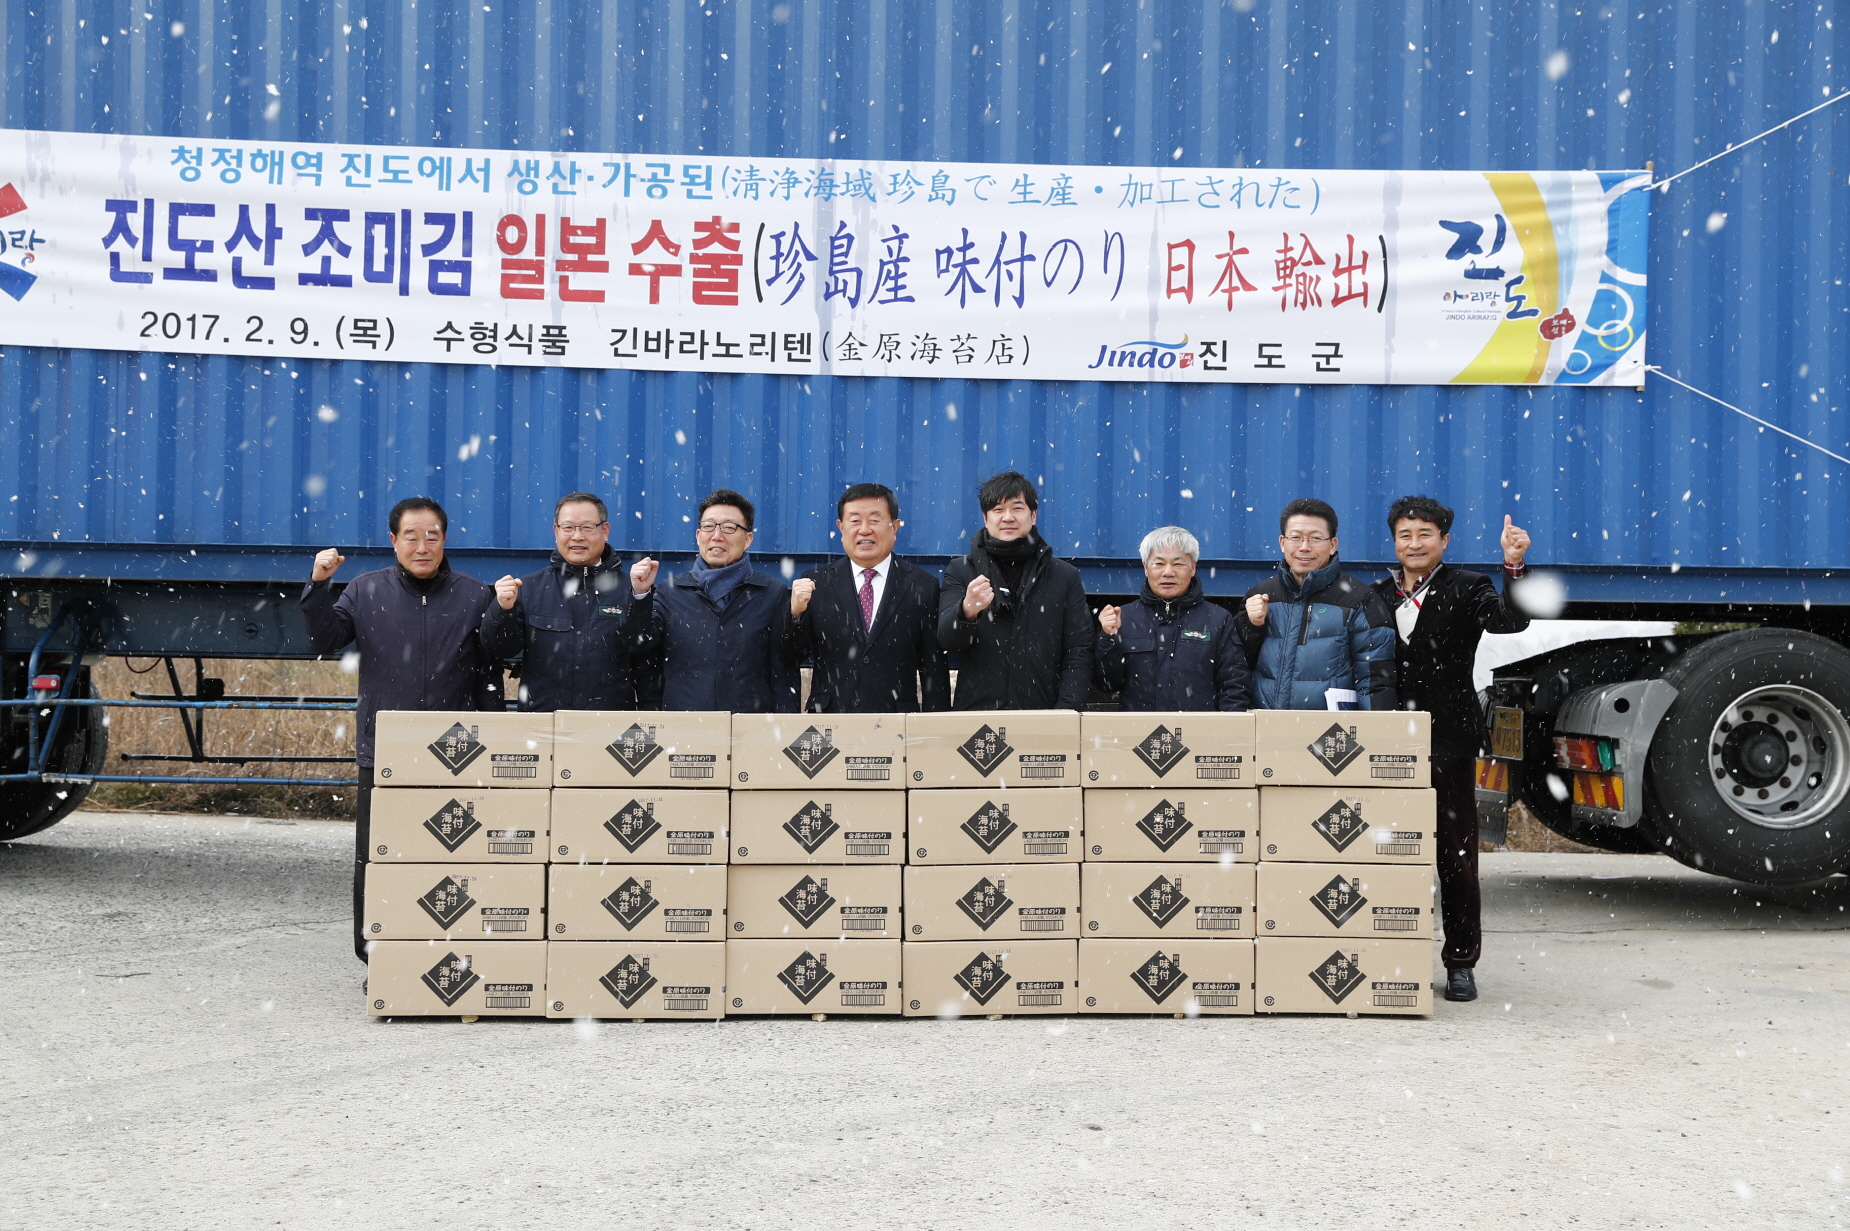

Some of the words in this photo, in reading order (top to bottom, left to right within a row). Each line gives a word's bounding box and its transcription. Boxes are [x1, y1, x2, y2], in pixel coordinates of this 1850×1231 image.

[170, 145, 324, 186] 청정해역
[339, 151, 491, 194] 진도에서
[101, 198, 284, 291] 진도산
[298, 206, 474, 297] 조미김
[495, 213, 610, 303] 일본
[140, 311, 230, 344] 2017.
[245, 316, 275, 345] 2.
[289, 318, 320, 347] 9.
[336, 316, 396, 351] (목)
[433, 321, 570, 356] 수형식품
[1088, 344, 1177, 369] Jindo
